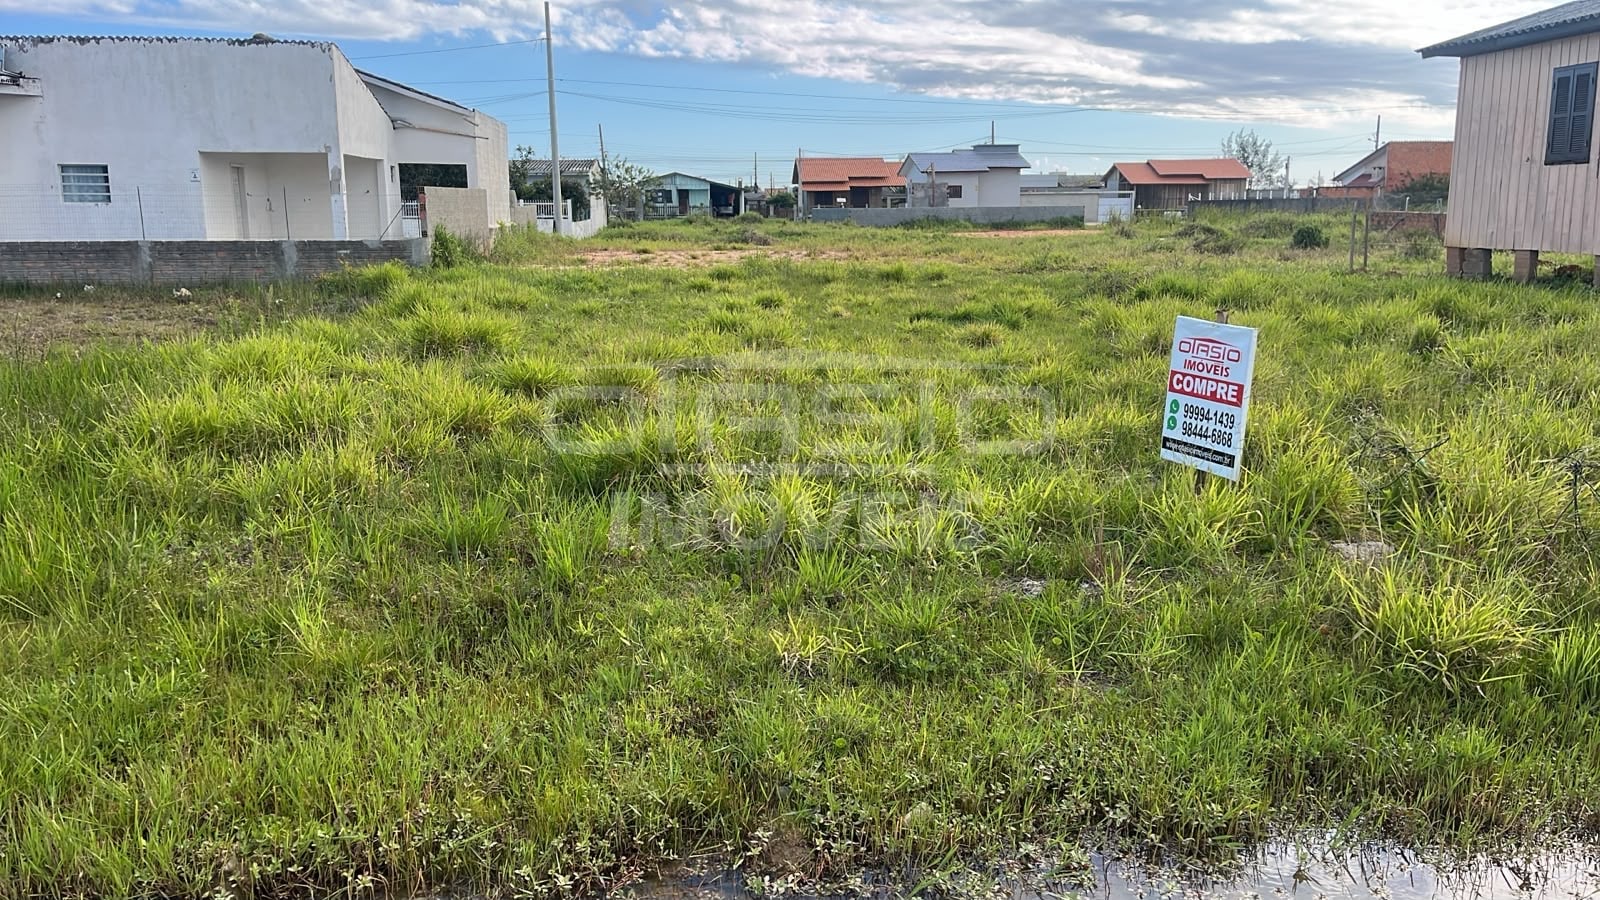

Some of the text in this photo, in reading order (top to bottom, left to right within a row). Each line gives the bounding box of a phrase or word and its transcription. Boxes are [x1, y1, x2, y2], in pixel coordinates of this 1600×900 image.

[1179, 340, 1241, 363] OTASIO
[1183, 359, 1230, 377] IMÓVEIS
[1173, 373, 1238, 403] COMPRE
[1184, 403, 1235, 430] 99994-1439
[1182, 421, 1233, 448] 98444-6868
